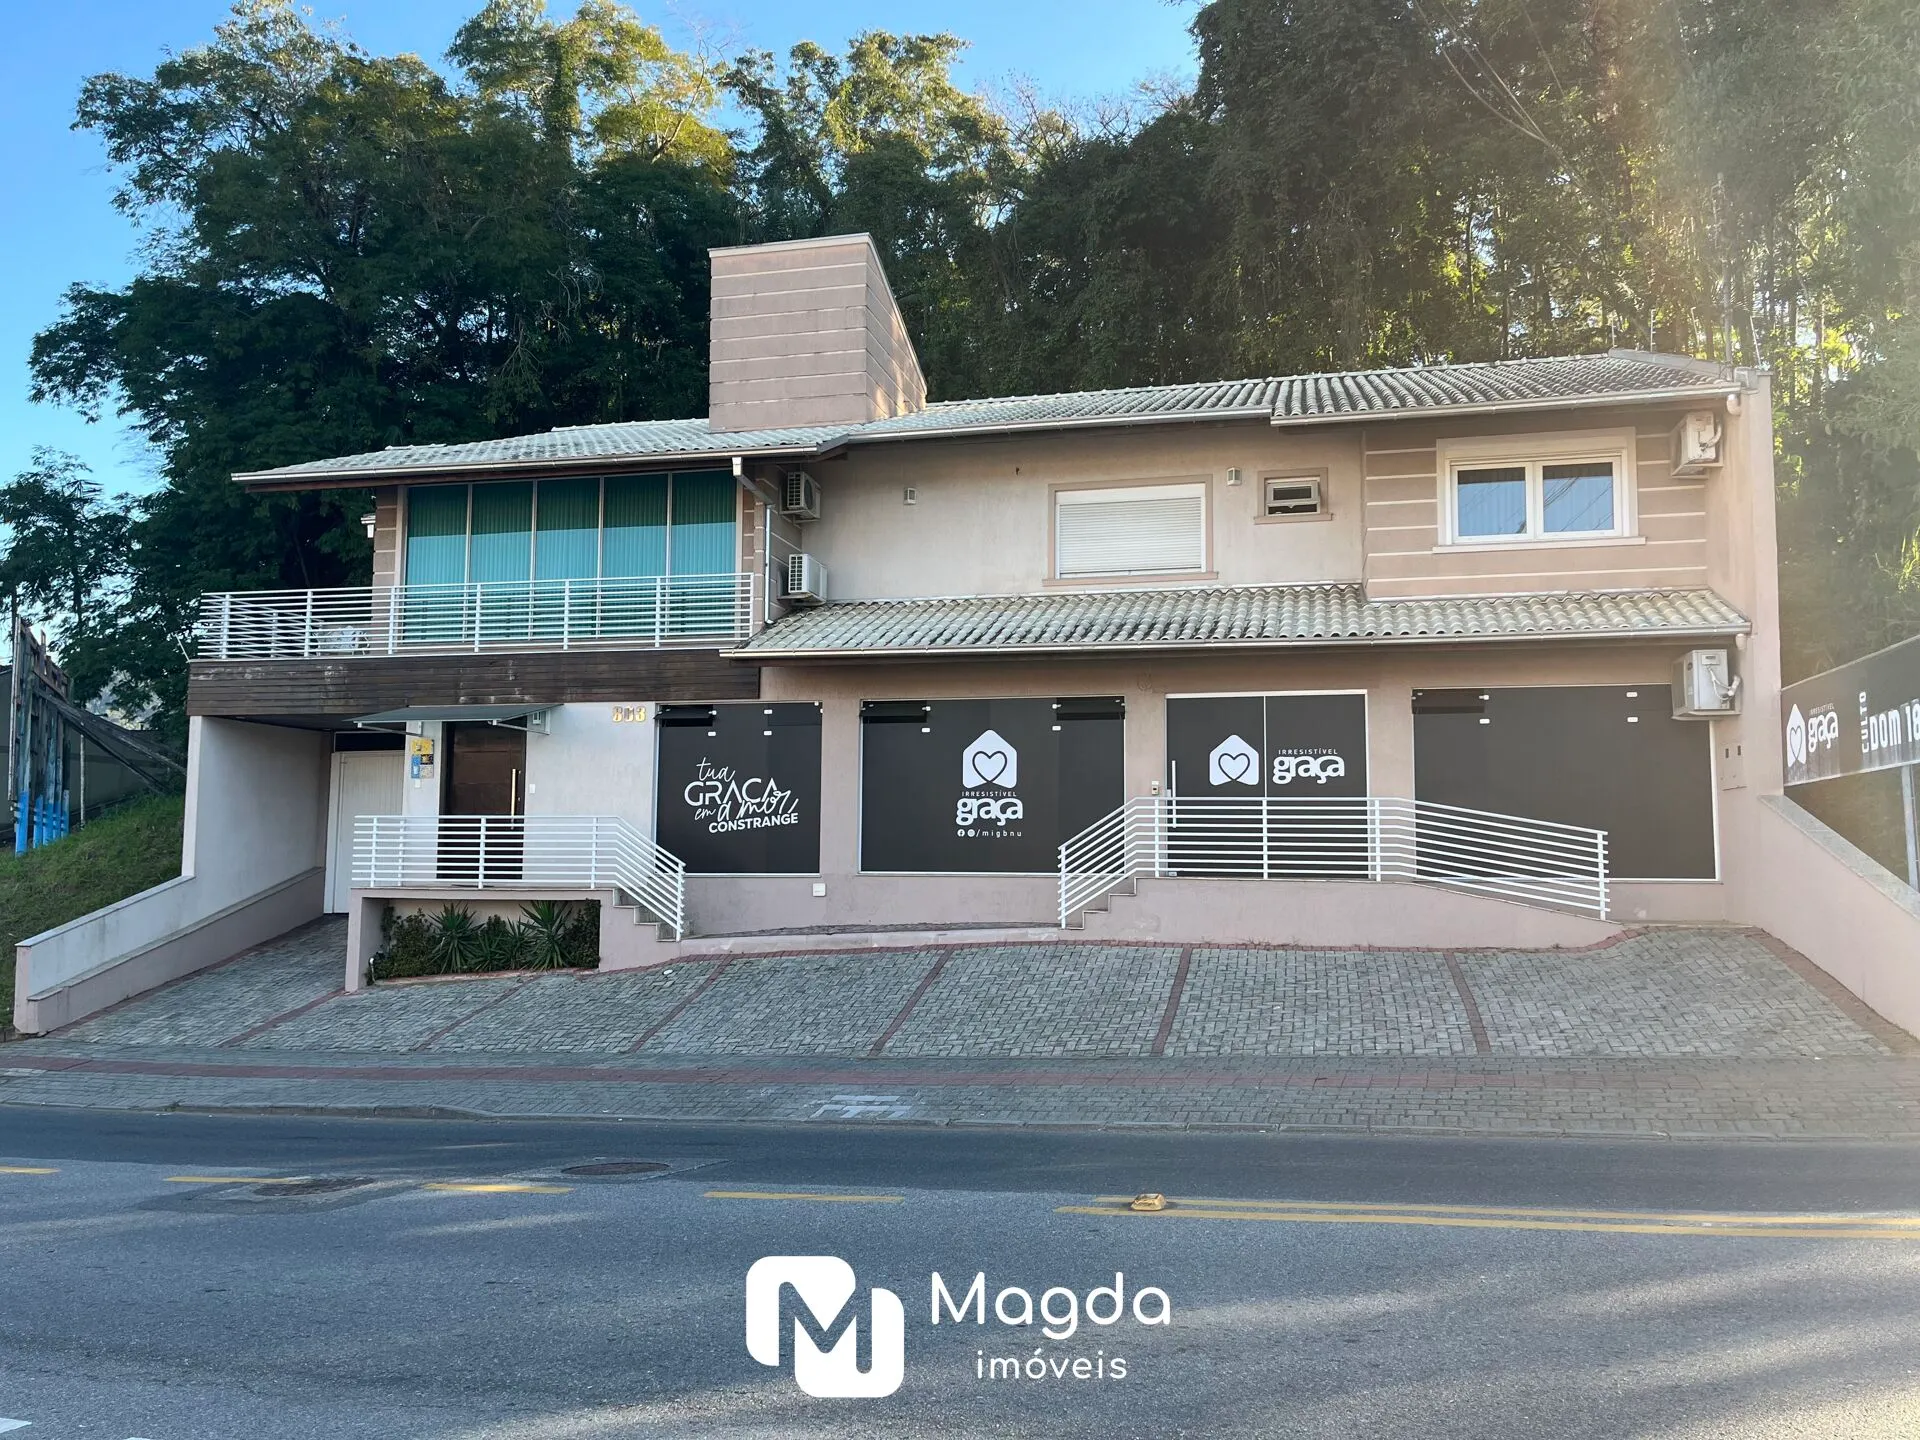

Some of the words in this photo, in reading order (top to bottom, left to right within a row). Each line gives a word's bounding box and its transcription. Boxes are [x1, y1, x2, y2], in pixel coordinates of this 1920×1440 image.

[1808, 711, 1839, 753] graça
[1859, 691, 1869, 753] CULTO
[1870, 709, 1901, 751] DOM
[1278, 747, 1338, 755] IRRESISTÍVEL
[696, 757, 736, 782] tua
[1272, 755, 1345, 785] graça
[694, 807, 717, 821] em
[708, 812, 799, 834] CONSTRANGE
[955, 797, 1024, 826] graça
